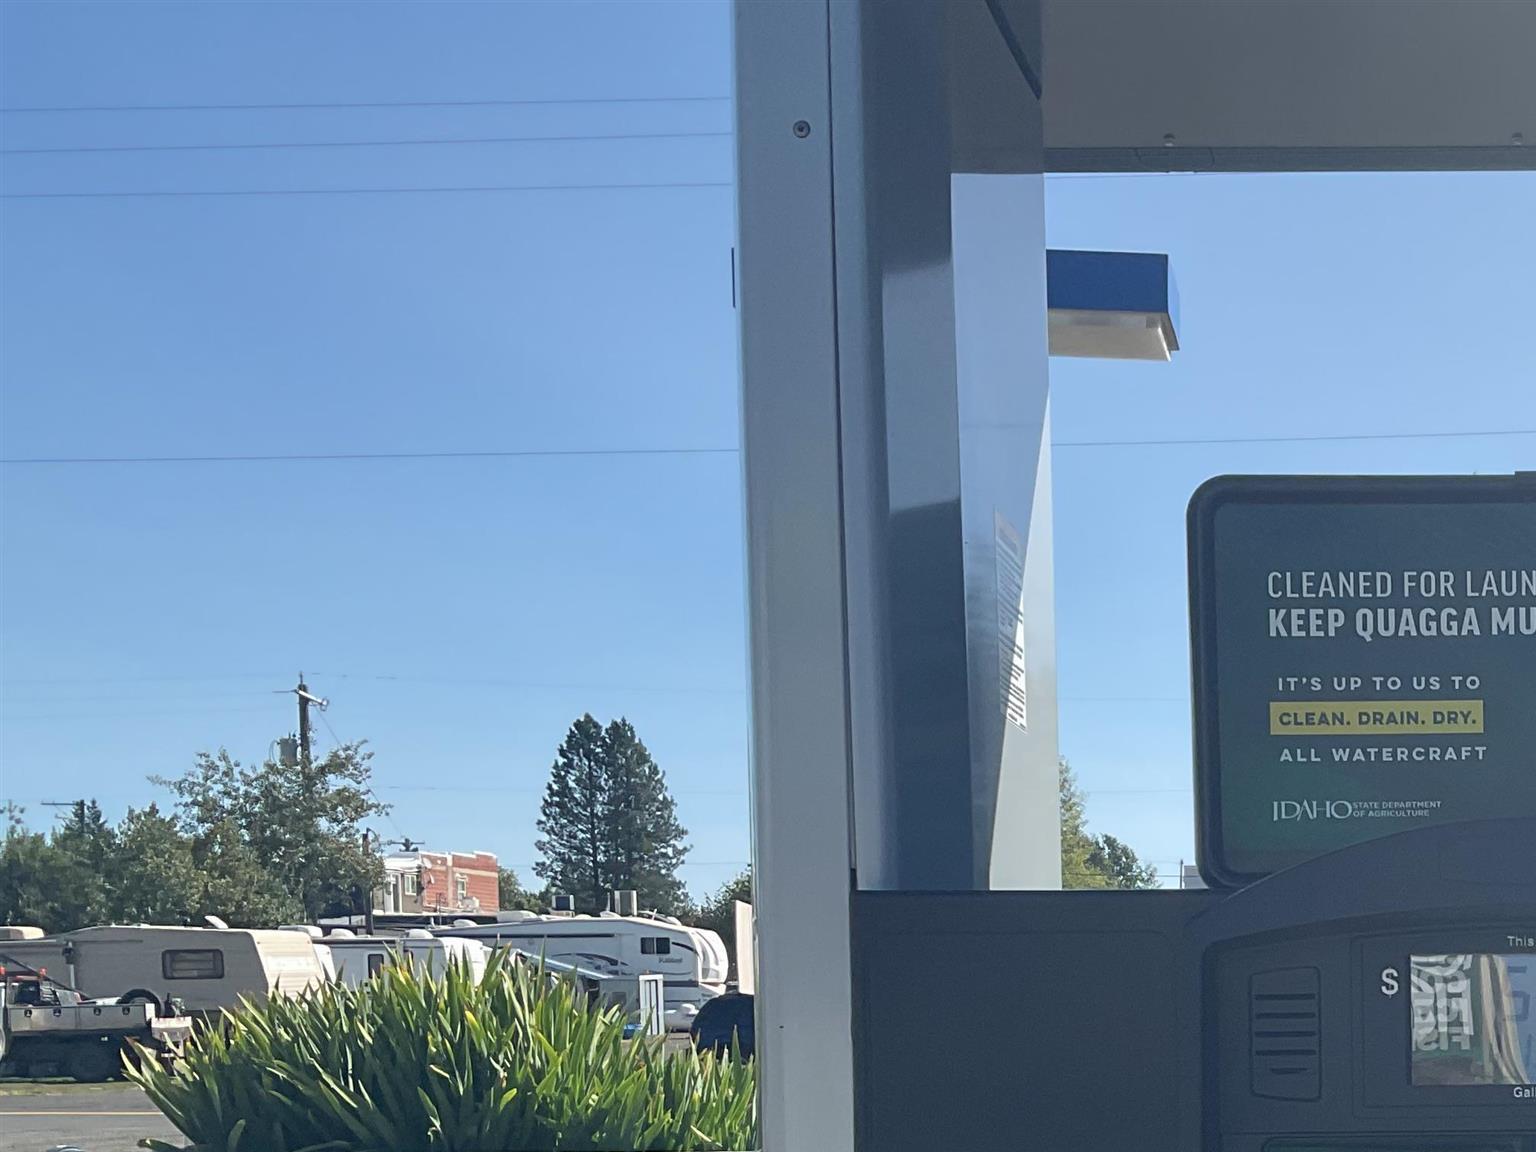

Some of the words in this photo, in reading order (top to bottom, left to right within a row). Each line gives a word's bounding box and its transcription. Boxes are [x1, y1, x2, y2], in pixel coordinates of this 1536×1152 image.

[1268, 571, 1392, 598] CLEANED
[1403, 571, 1455, 598] FOR
[1269, 608, 1345, 637] KEEP
[1355, 607, 1481, 642] QUAGGA
[1278, 677, 1322, 691] IT'S
[1333, 677, 1362, 691] UP
[1371, 676, 1402, 691] TO
[1412, 676, 1441, 690] US
[1450, 675, 1480, 690] TO
[1278, 711, 1351, 726] CLEAN.
[1358, 710, 1426, 726] DRAIN.
[1432, 709, 1477, 725] DRY.
[1279, 748, 1321, 762] ALL
[1331, 746, 1487, 762] WATERCRAFT
[1273, 799, 1353, 822] IDAHO
[1353, 801, 1379, 809] STATE
[1382, 801, 1441, 809] DEPARTMENT
[1508, 935, 1535, 947] This
[1381, 968, 1399, 998] $
